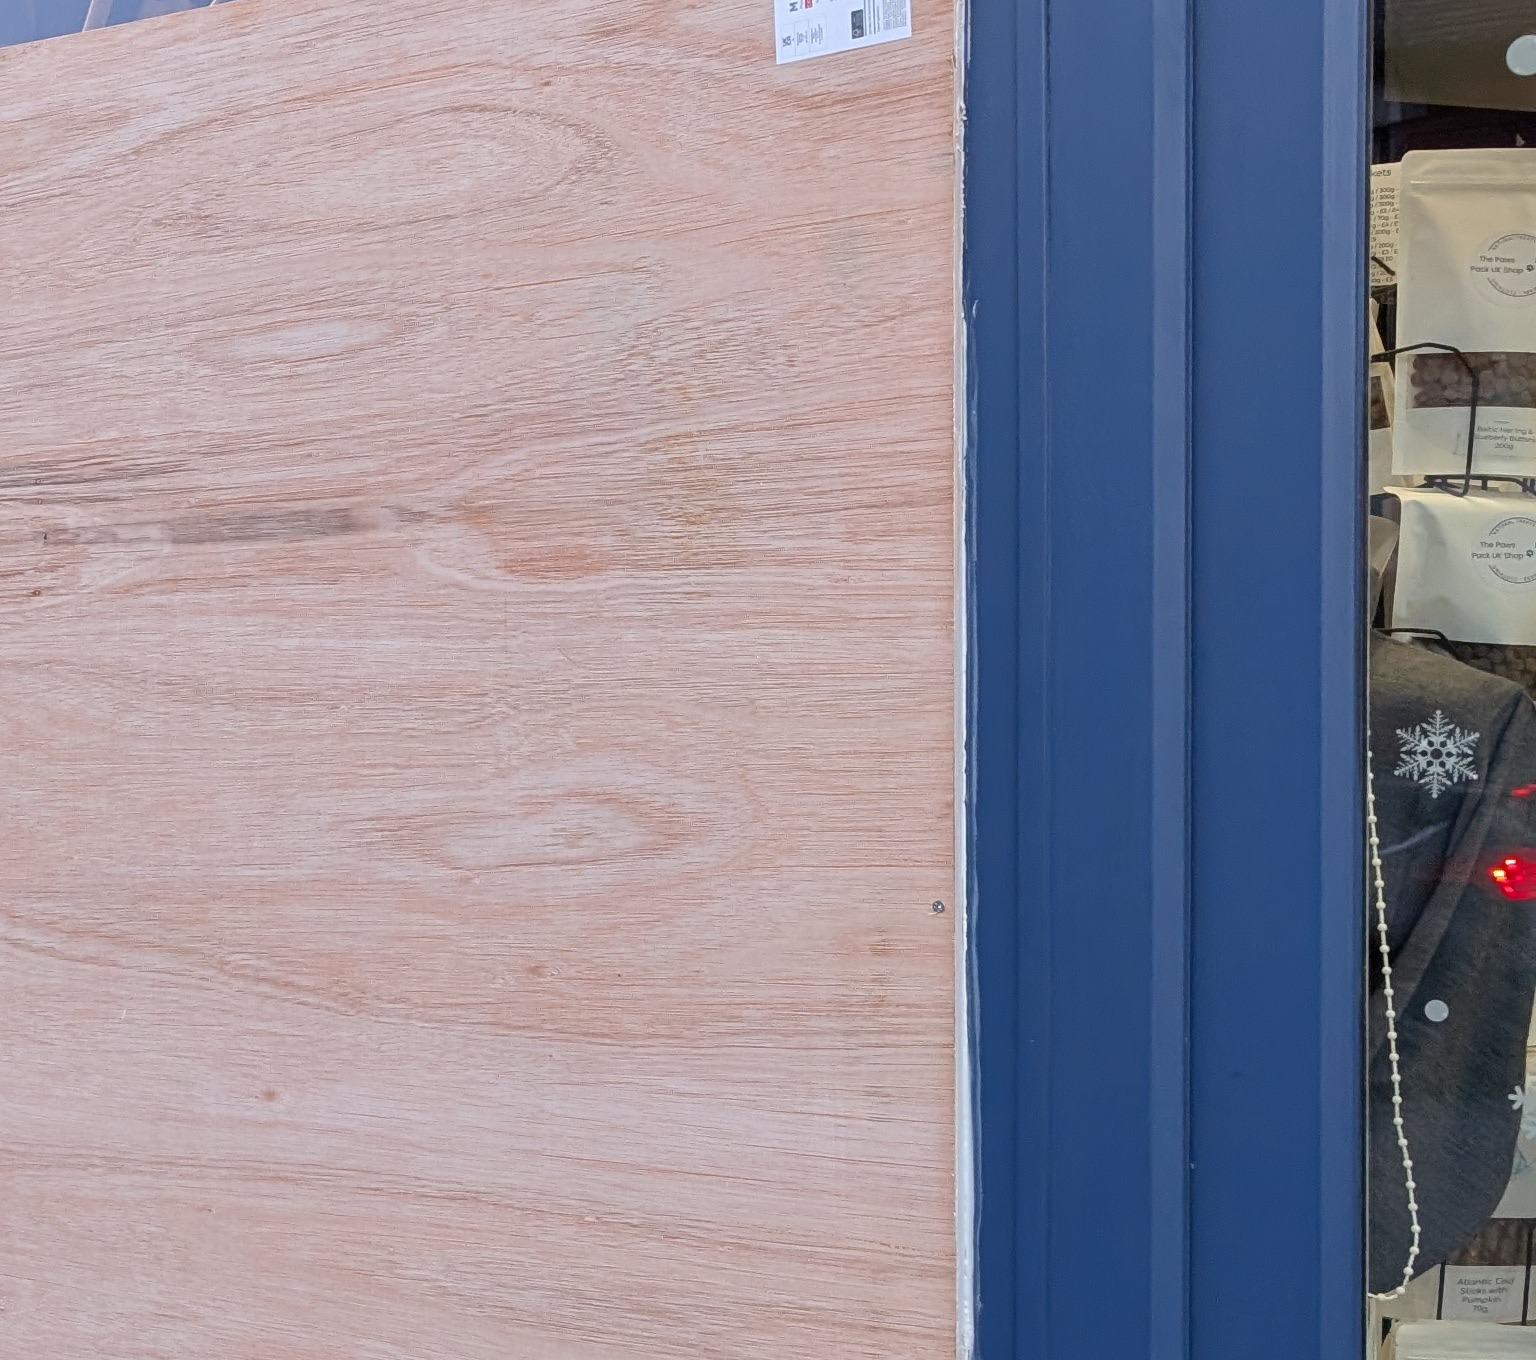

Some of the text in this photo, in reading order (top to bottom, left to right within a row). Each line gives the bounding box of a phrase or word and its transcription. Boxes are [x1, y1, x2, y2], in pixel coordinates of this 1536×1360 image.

[1479, 255, 1515, 263] The Paws
[1470, 265, 1489, 273] Pack
[1503, 266, 1524, 275] Shop
[1479, 541, 1516, 549] The Paws
